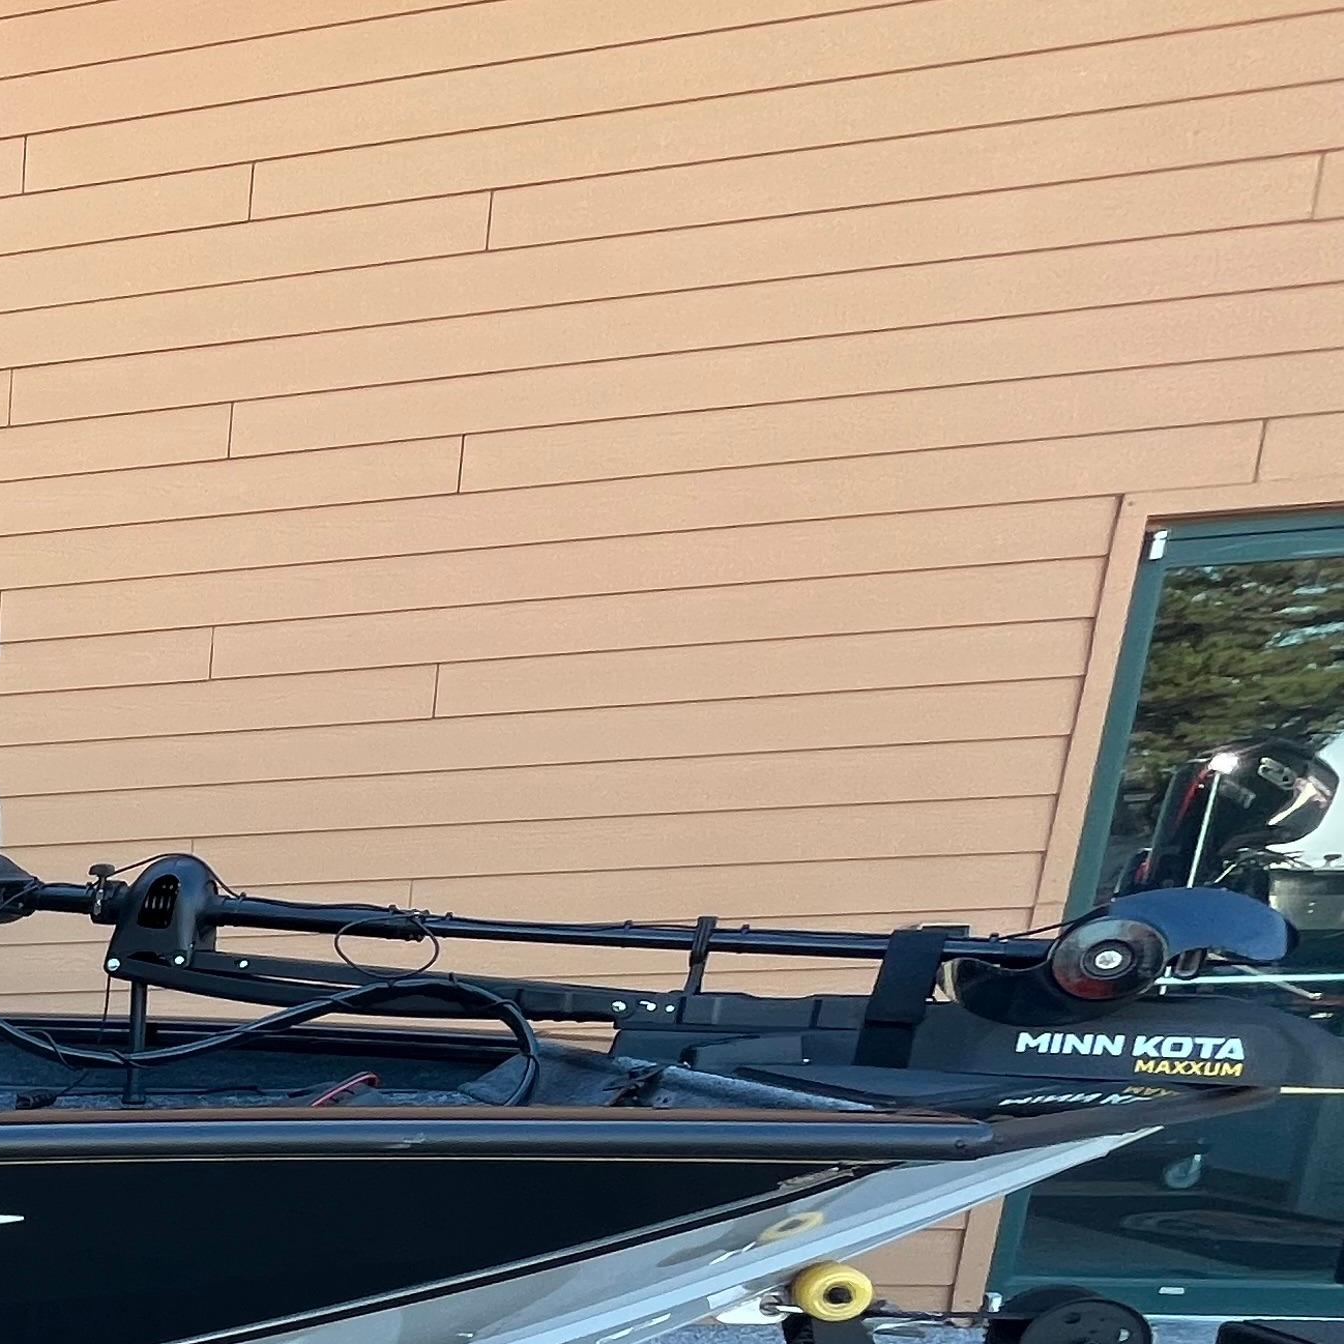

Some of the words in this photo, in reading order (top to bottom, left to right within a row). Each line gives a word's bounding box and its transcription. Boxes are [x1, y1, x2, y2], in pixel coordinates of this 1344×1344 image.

[1015, 1032, 1125, 1056] MINN
[1132, 1035, 1245, 1060] KOTA
[1134, 1059, 1244, 1077] MAXXUM
